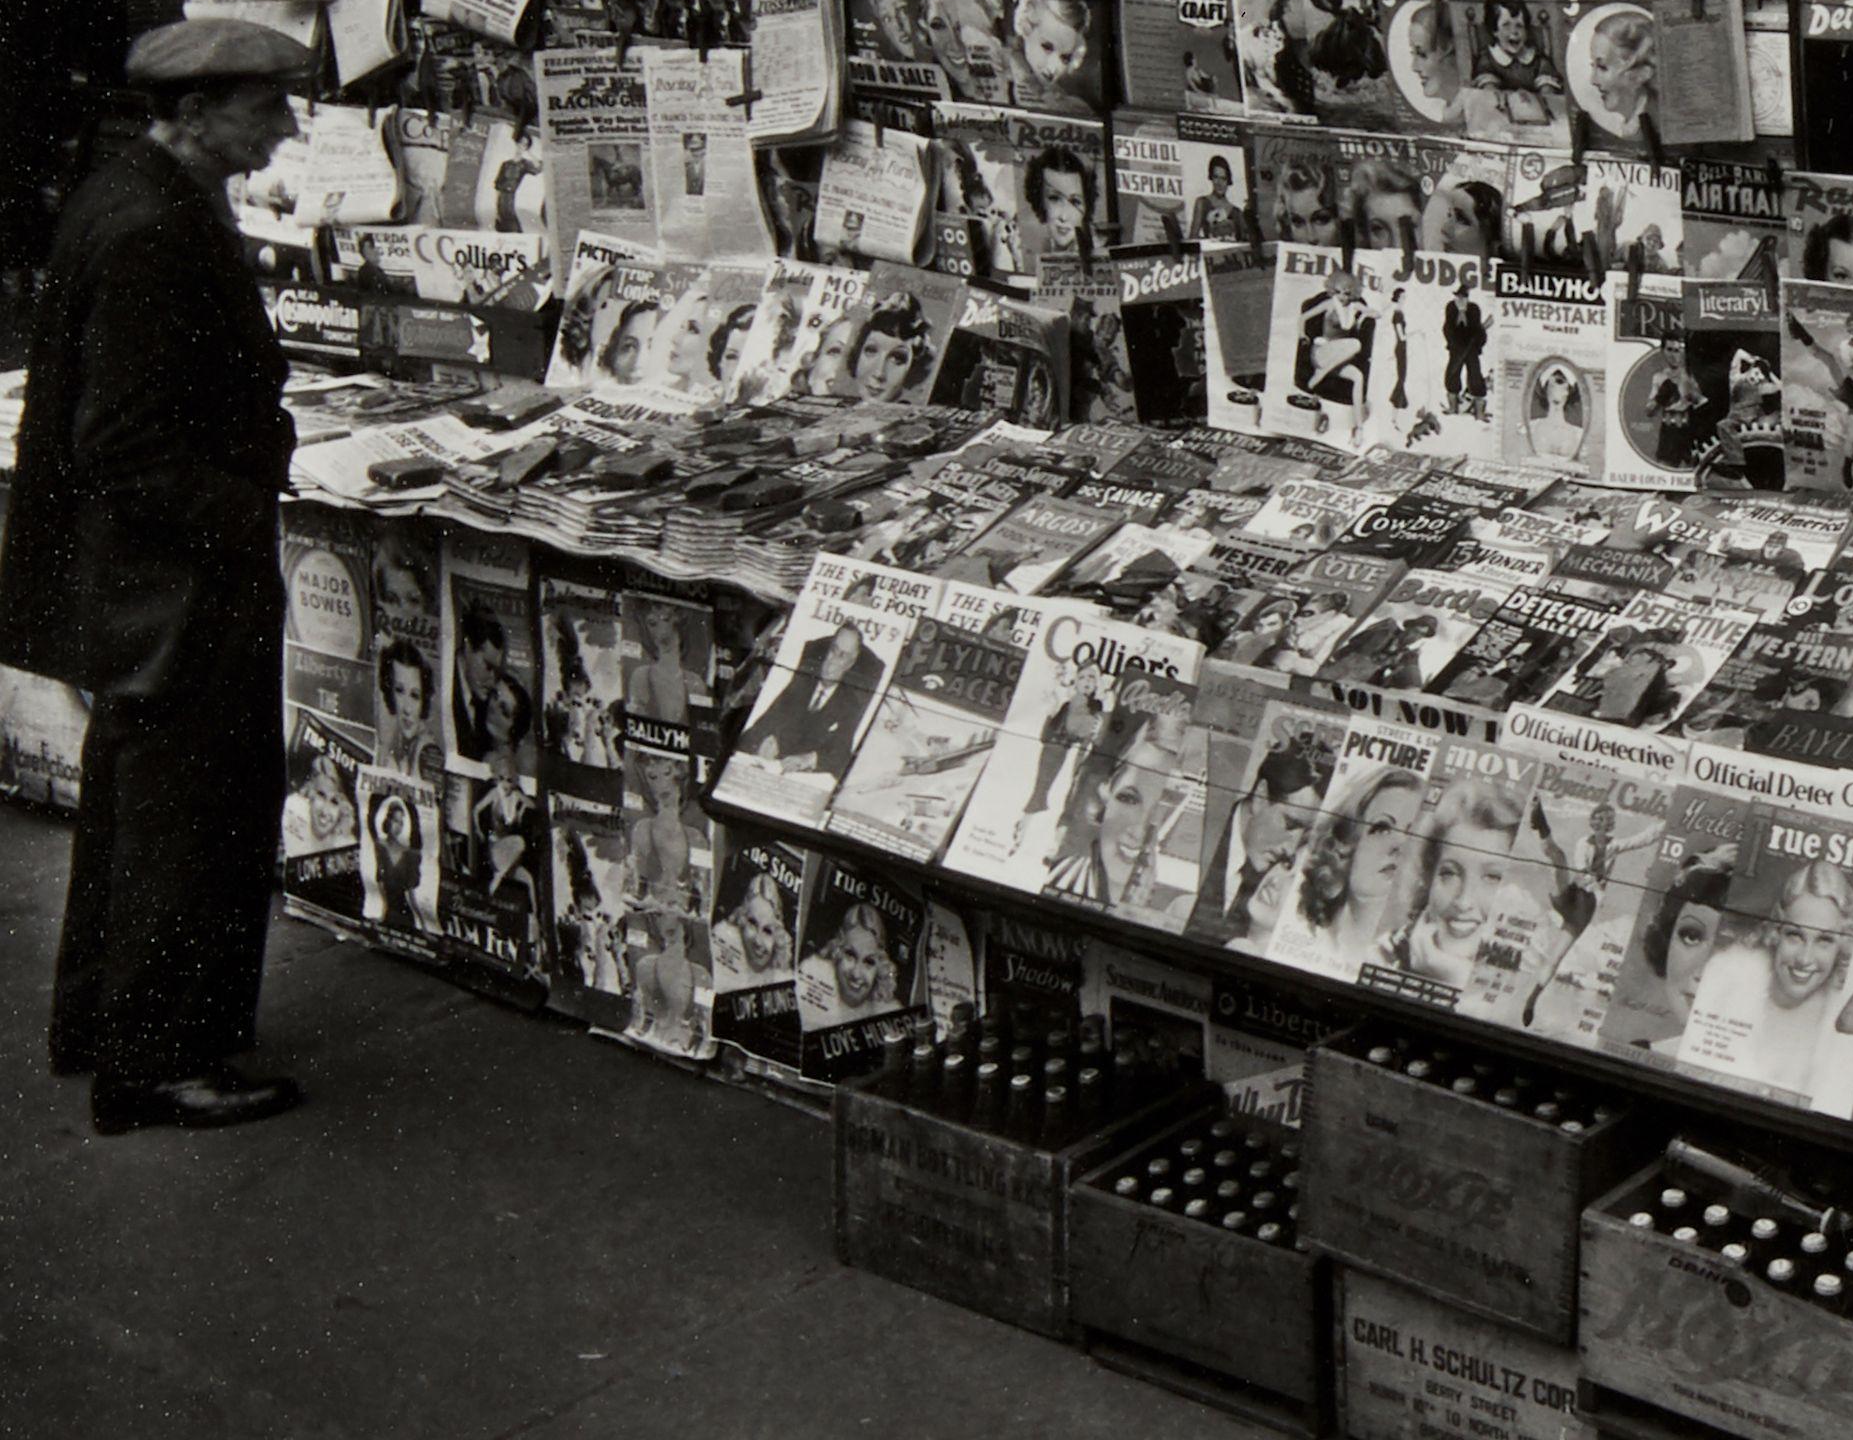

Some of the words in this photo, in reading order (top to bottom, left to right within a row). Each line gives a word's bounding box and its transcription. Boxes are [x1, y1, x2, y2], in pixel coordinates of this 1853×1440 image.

[1184, 3, 1228, 20] CRAFT
[440, 244, 527, 271] Collier's
[1395, 252, 1498, 288] JUDGE
[1094, 487, 1163, 510] SAVAGE
[1017, 508, 1100, 541] ARGOSY
[1354, 506, 1459, 540] Cowboy
[816, 562, 847, 580] THE
[1475, 547, 1545, 575] WONDER
[1572, 557, 1664, 583] MECHANIX
[299, 572, 350, 597] MAJOR
[300, 591, 353, 619] BOWES
[885, 598, 926, 620] POST
[950, 592, 987, 613] THE
[811, 598, 882, 642] Liberty
[1625, 602, 1744, 646] DETECTIVE
[1045, 615, 1180, 685] Collier's
[1343, 732, 1427, 770] PICTURE
[1510, 712, 1592, 750] Official
[1592, 732, 1675, 770] Detective
[1694, 755, 1772, 792] Official
[1661, 837, 1685, 859] 10
[822, 1030, 860, 1057] LOVE
[1354, 1317, 1403, 1357] CARL
[1410, 1336, 1427, 1365] H.
[1432, 1345, 1526, 1398] SCHULTZ
[1425, 1379, 1462, 1402] BERRY
[1470, 1395, 1516, 1422] STREET
